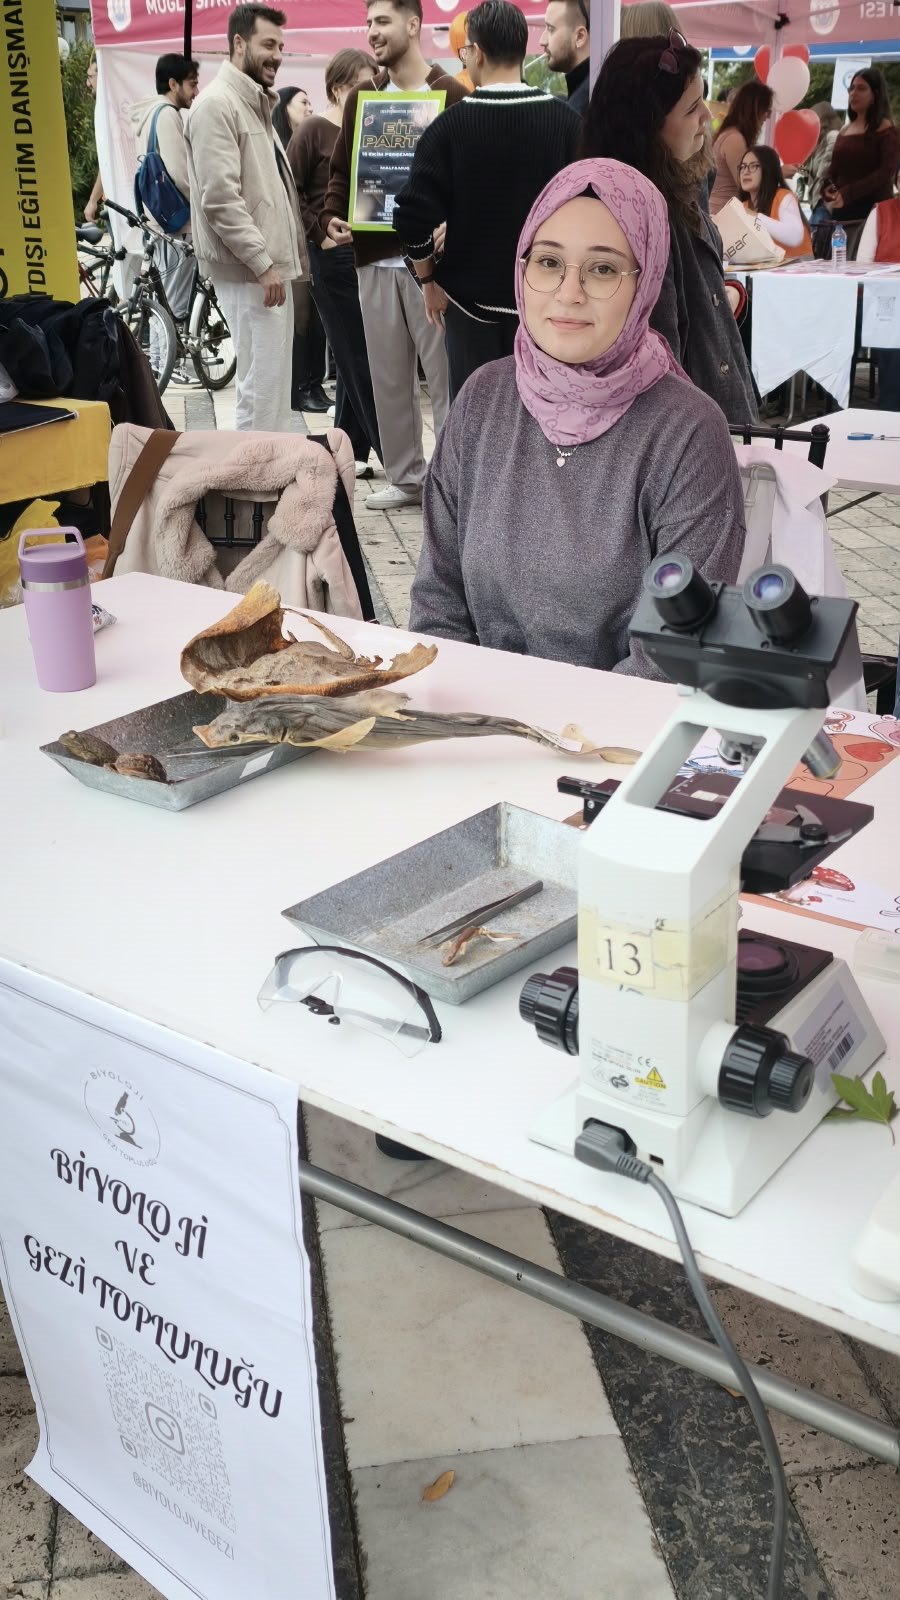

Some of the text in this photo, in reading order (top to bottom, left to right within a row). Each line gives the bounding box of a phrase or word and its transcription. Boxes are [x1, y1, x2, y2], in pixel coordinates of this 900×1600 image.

[362, 134, 421, 149] PART
[15, 143, 40, 229] EĞİTİM
[604, 938, 642, 976] 13
[114, 1240, 156, 1286] VE
[23, 1234, 283, 1418] GEZİ TOPLULUĞU
